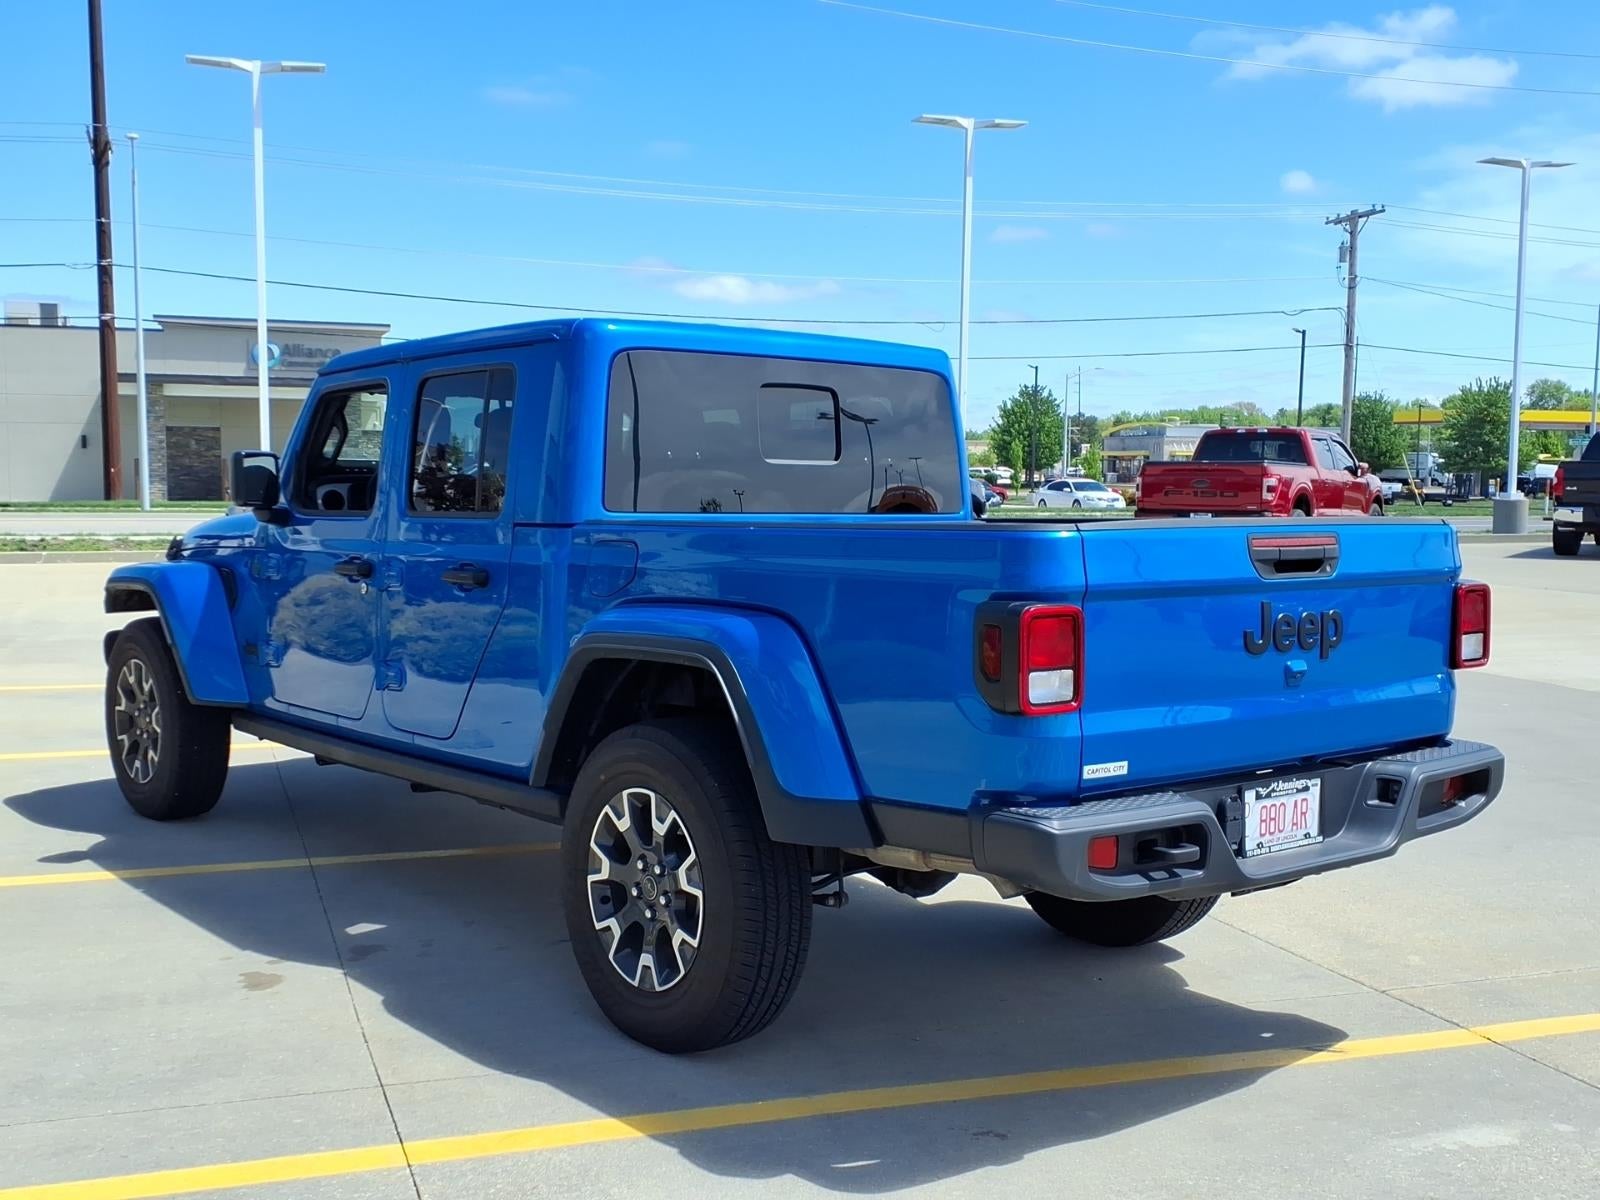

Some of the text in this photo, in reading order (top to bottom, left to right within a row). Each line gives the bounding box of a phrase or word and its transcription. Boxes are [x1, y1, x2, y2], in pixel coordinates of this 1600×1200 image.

[282, 344, 341, 358] Alliance
[1164, 489, 1238, 498] F-150
[1243, 600, 1343, 660] Jeep
[1087, 767, 1111, 775] CAPITOL
[1260, 798, 1308, 837] 880 AR
